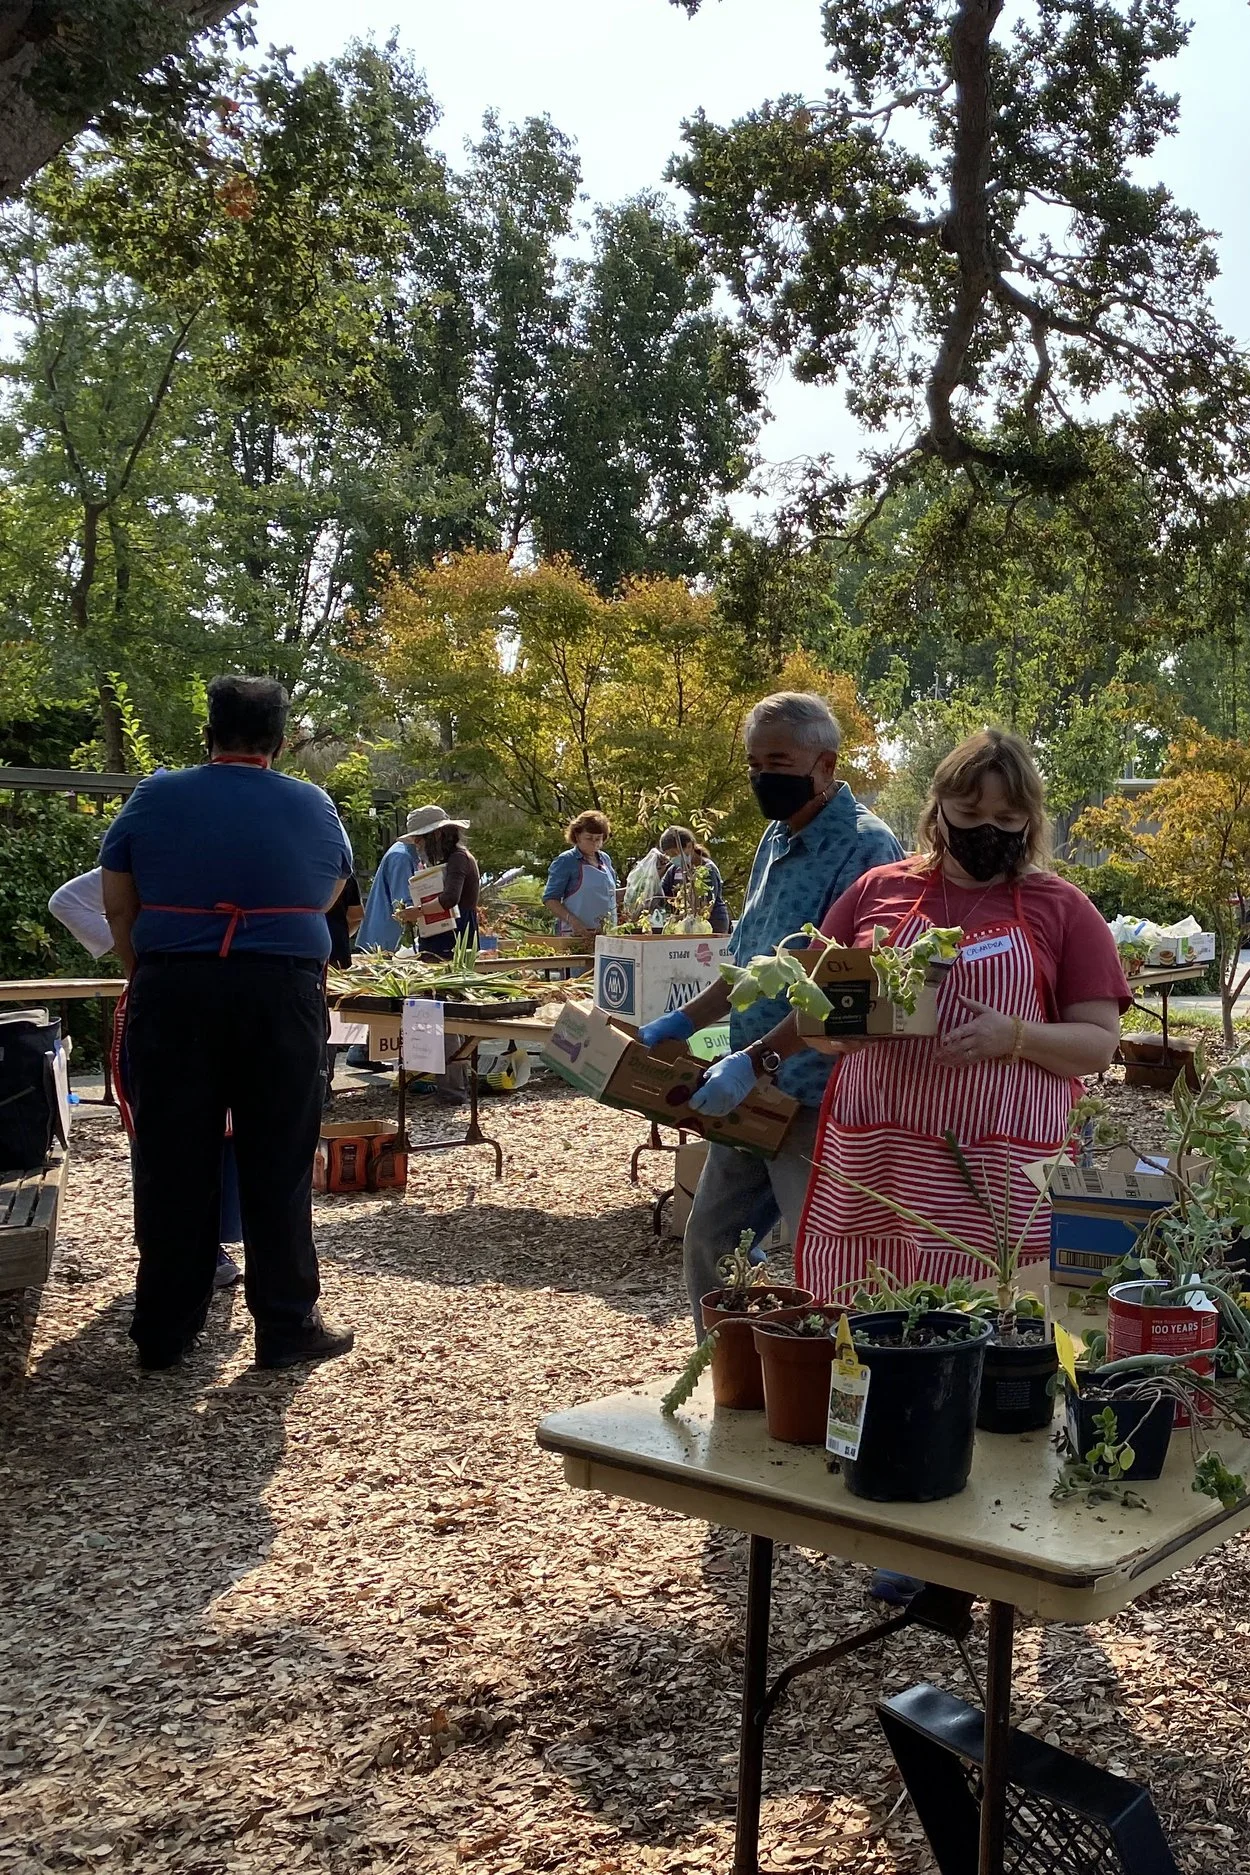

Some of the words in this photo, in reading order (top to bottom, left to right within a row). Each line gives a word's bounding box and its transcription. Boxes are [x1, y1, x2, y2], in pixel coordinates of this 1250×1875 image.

[669, 951, 690, 960] APPLES
[1151, 1325, 1169, 1335] 100
[1170, 1321, 1199, 1334] YEARS
